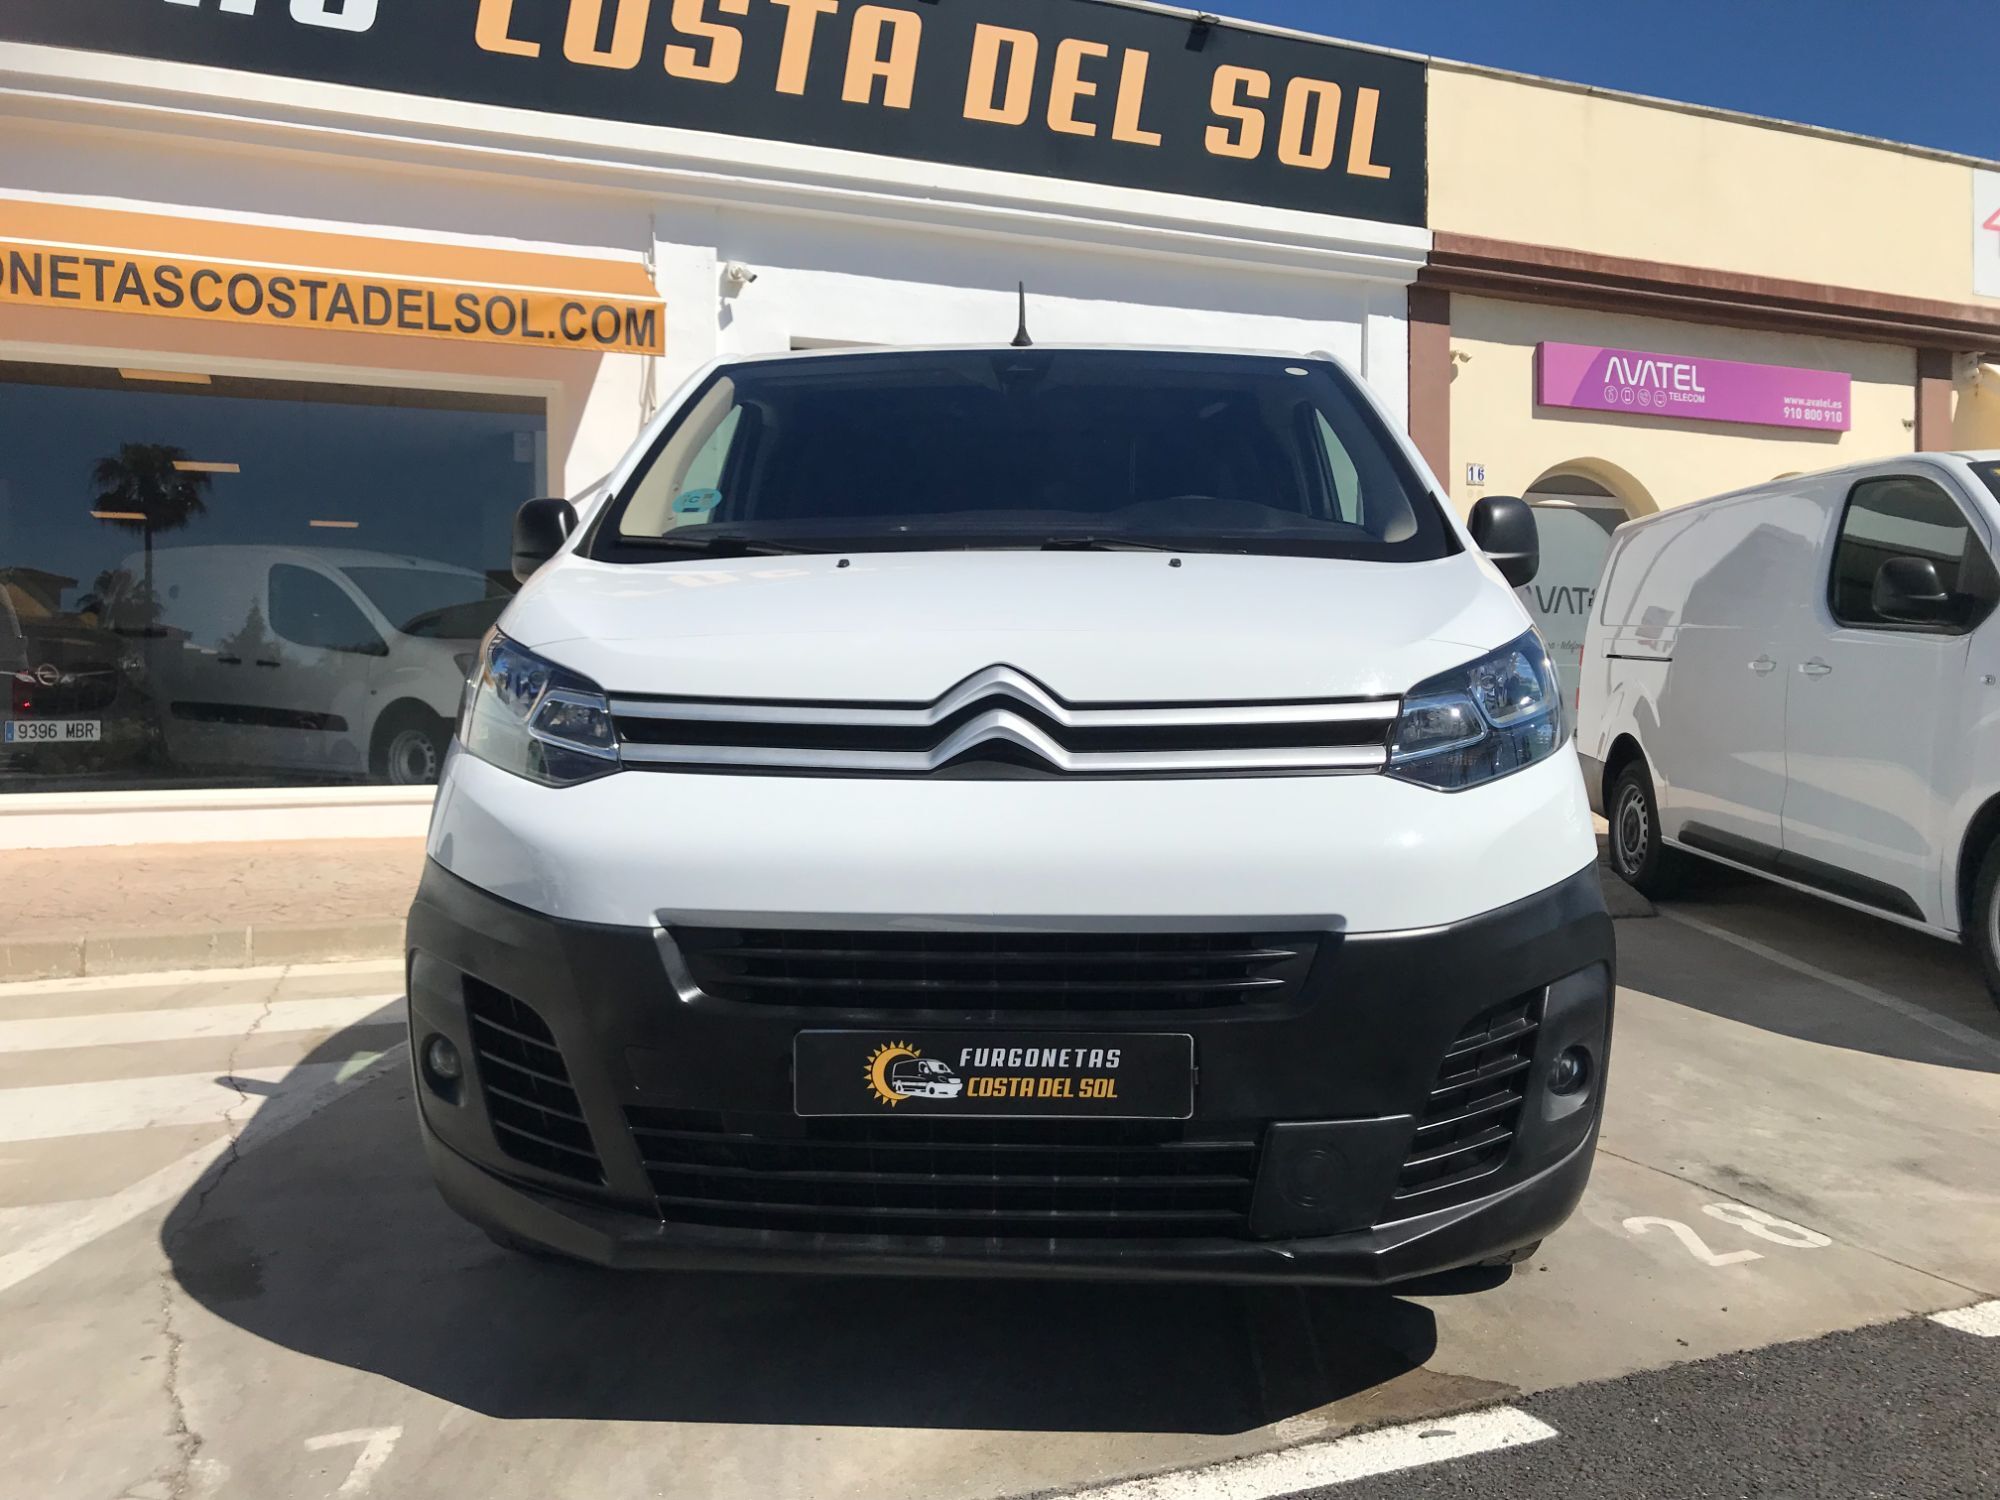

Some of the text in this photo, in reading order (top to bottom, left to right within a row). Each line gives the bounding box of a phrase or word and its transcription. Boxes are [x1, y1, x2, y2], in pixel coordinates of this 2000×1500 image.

[474, 0, 1391, 179] COSTA DEL SOL
[0, 250, 656, 348] NETASCOSTADELSOL.COM
[1604, 356, 1705, 392] AVATEL
[1668, 391, 1705, 403] TELECOM
[1783, 397, 1843, 409] www.avatel.es
[1783, 406, 1843, 423] 910 800 910
[1469, 466, 1485, 481] 16
[18, 722, 95, 739] 9396 MBR
[960, 1048, 1121, 1069] FURGONETAS
[967, 1077, 1118, 1098] COSTA DEL SOL
[1621, 1202, 1833, 1267] 28
